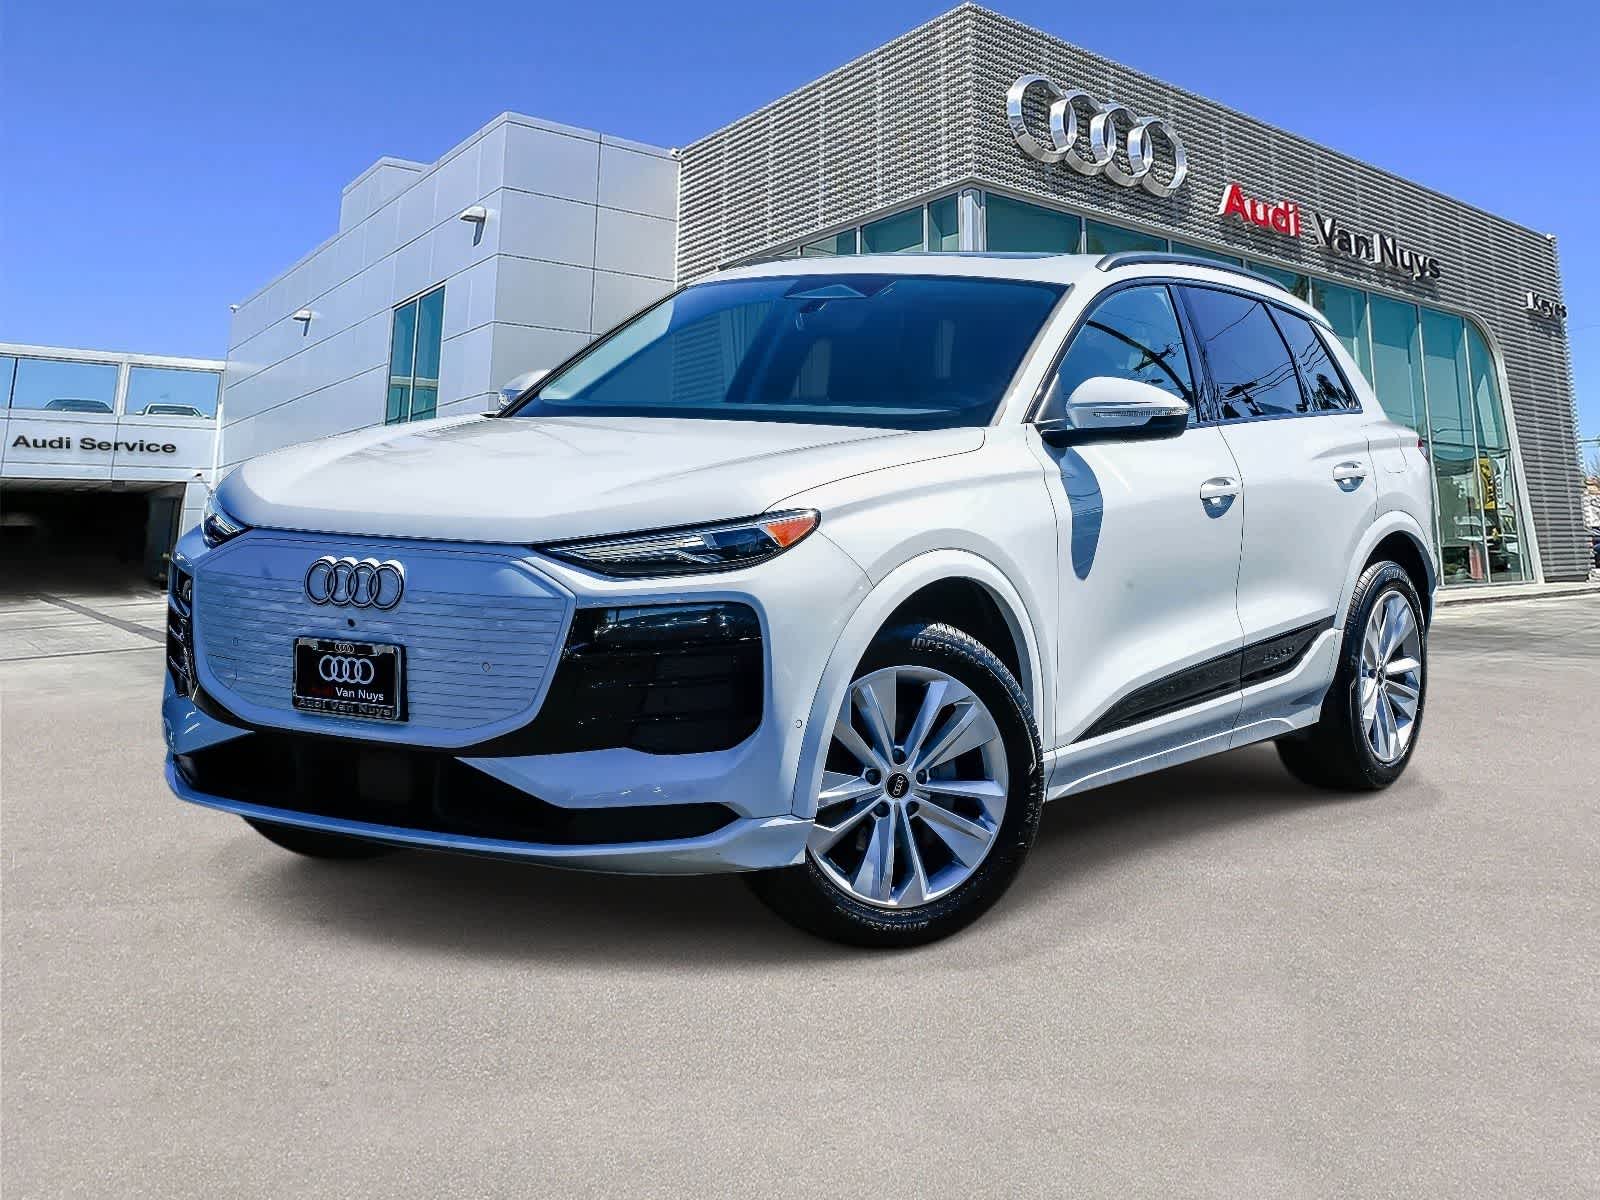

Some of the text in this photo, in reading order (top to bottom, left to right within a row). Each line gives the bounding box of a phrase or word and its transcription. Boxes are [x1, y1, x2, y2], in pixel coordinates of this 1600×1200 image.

[1217, 183, 1441, 280] Audi Van Nuys
[12, 435, 177, 453] Audi Service
[335, 687, 355, 698] Van
[358, 690, 384, 702] Nuys
